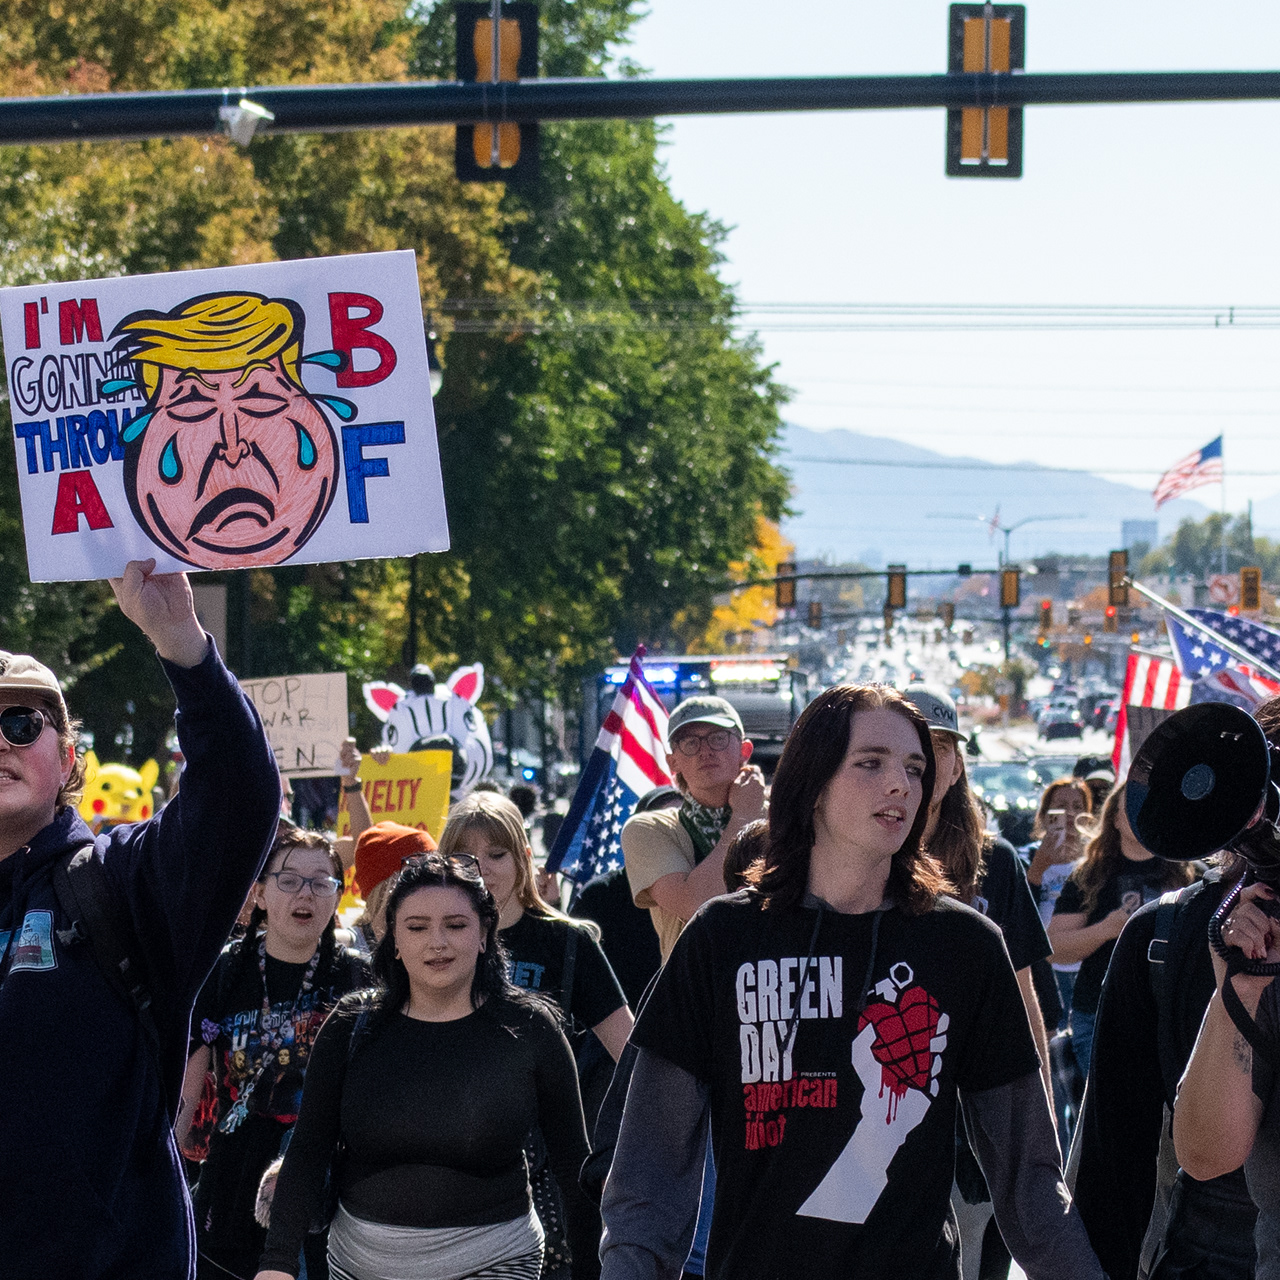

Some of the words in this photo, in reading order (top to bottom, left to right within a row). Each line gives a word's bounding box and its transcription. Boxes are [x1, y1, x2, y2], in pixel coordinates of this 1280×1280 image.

[23, 296, 105, 351] I'M
[327, 291, 398, 389] B
[11, 346, 148, 417] GONNA
[50, 470, 116, 536] A
[340, 420, 407, 524] F
[242, 677, 301, 710] TOP
[261, 708, 315, 728] WAR
[735, 956, 843, 1024] GREEN
[739, 1020, 800, 1084] DAY
[743, 1071, 838, 1112] american
[745, 1112, 788, 1150] idiot
